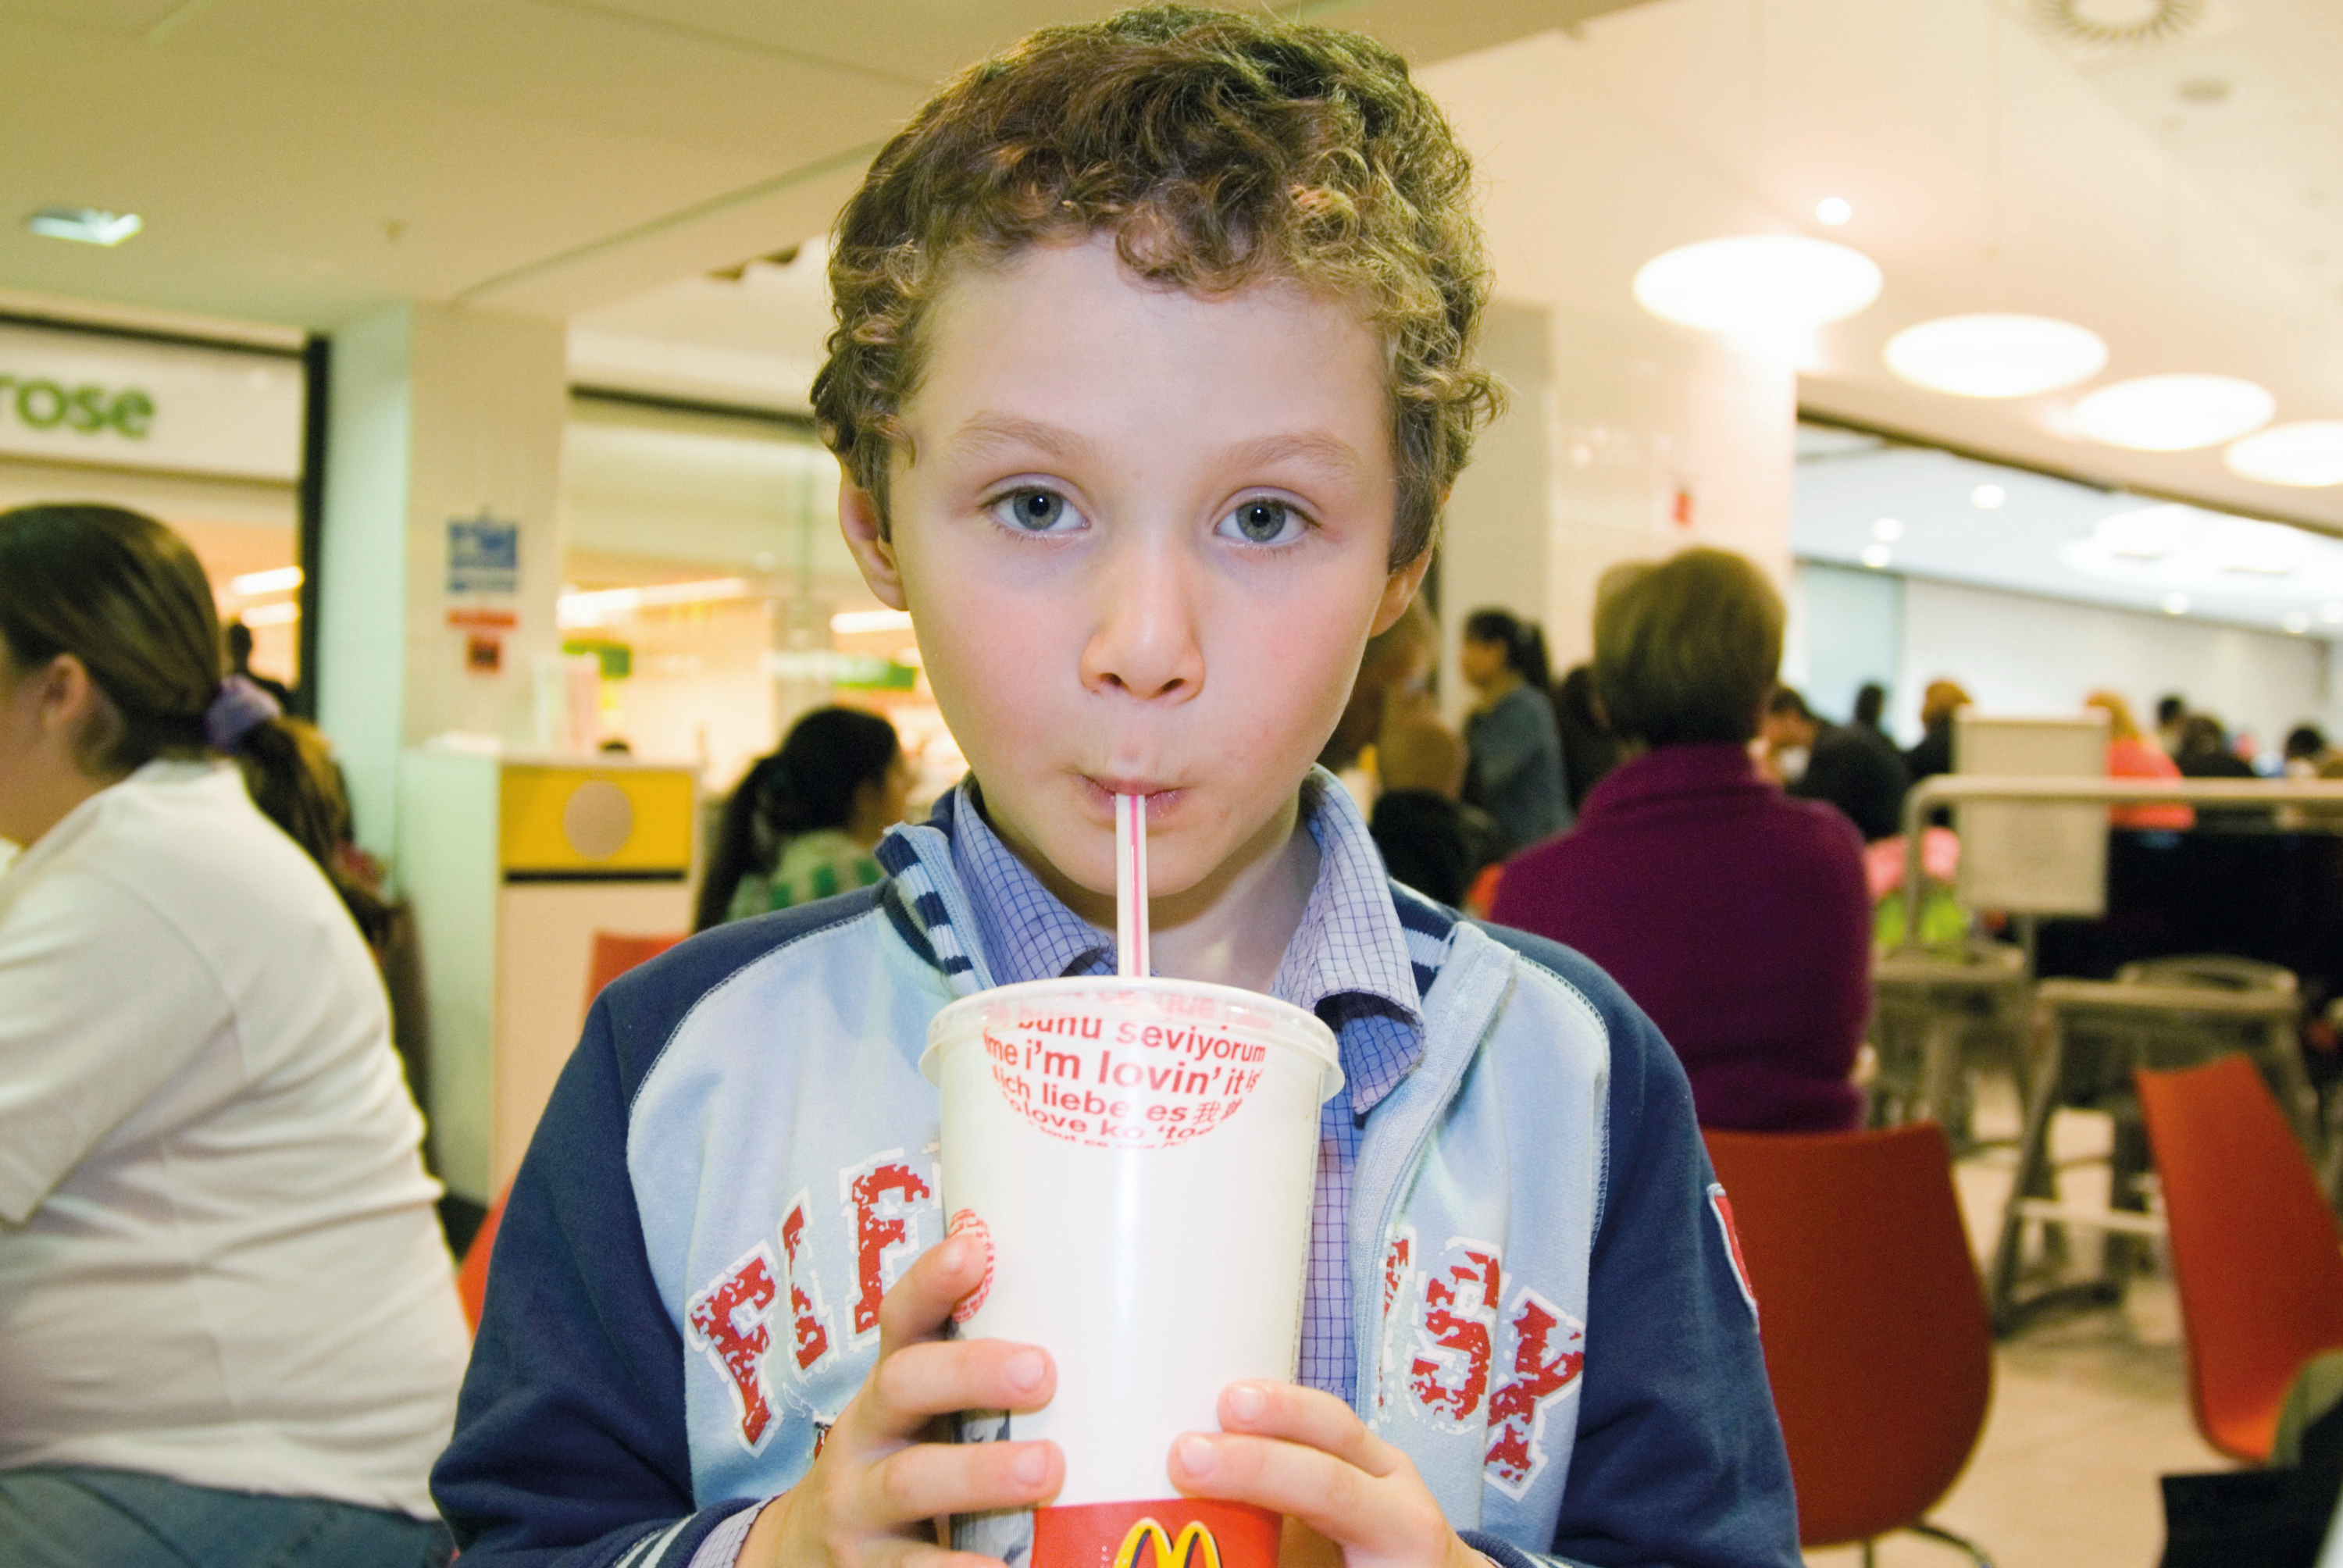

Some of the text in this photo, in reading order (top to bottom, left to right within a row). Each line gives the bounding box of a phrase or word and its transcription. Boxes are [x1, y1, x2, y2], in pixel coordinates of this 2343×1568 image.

[1116, 1022, 1266, 1063] seviyorum
[1025, 1039, 1081, 1080] i'm
[1098, 1049, 1221, 1094] lovin'
[1223, 1067, 1245, 1096] it
[1024, 1100, 1088, 1133] love
[1100, 1118, 1145, 1139] ko
[1043, 1082, 1129, 1119] liebe
[1145, 1104, 1189, 1122] es
